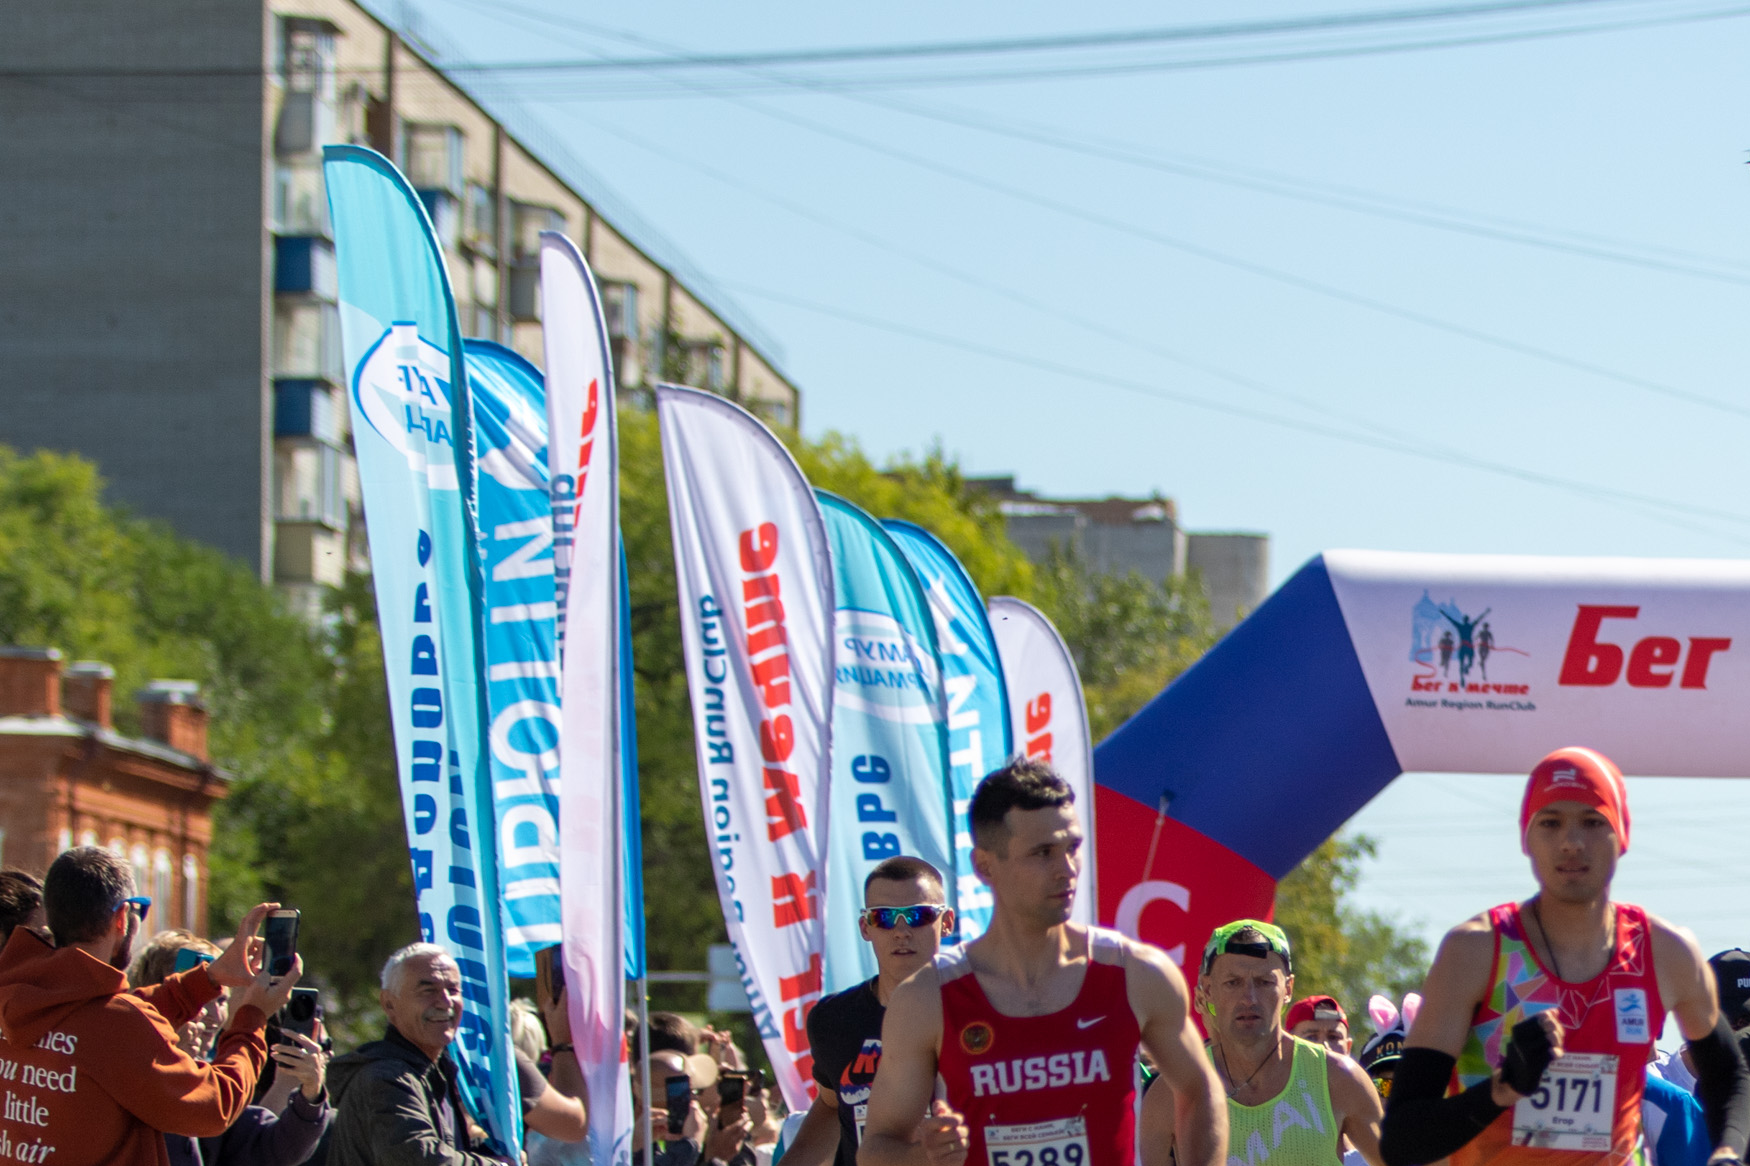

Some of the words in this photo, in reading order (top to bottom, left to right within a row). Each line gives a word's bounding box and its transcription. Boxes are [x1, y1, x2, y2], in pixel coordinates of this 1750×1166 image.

[1557, 604, 1732, 691] Бег
[1486, 700, 1536, 711] RunClub
[22, 1063, 77, 1093] need
[970, 1049, 1111, 1097] RUSSIA
[4, 1091, 50, 1127] little
[1530, 1076, 1602, 1113] 5171
[16, 1138, 56, 1164] air
